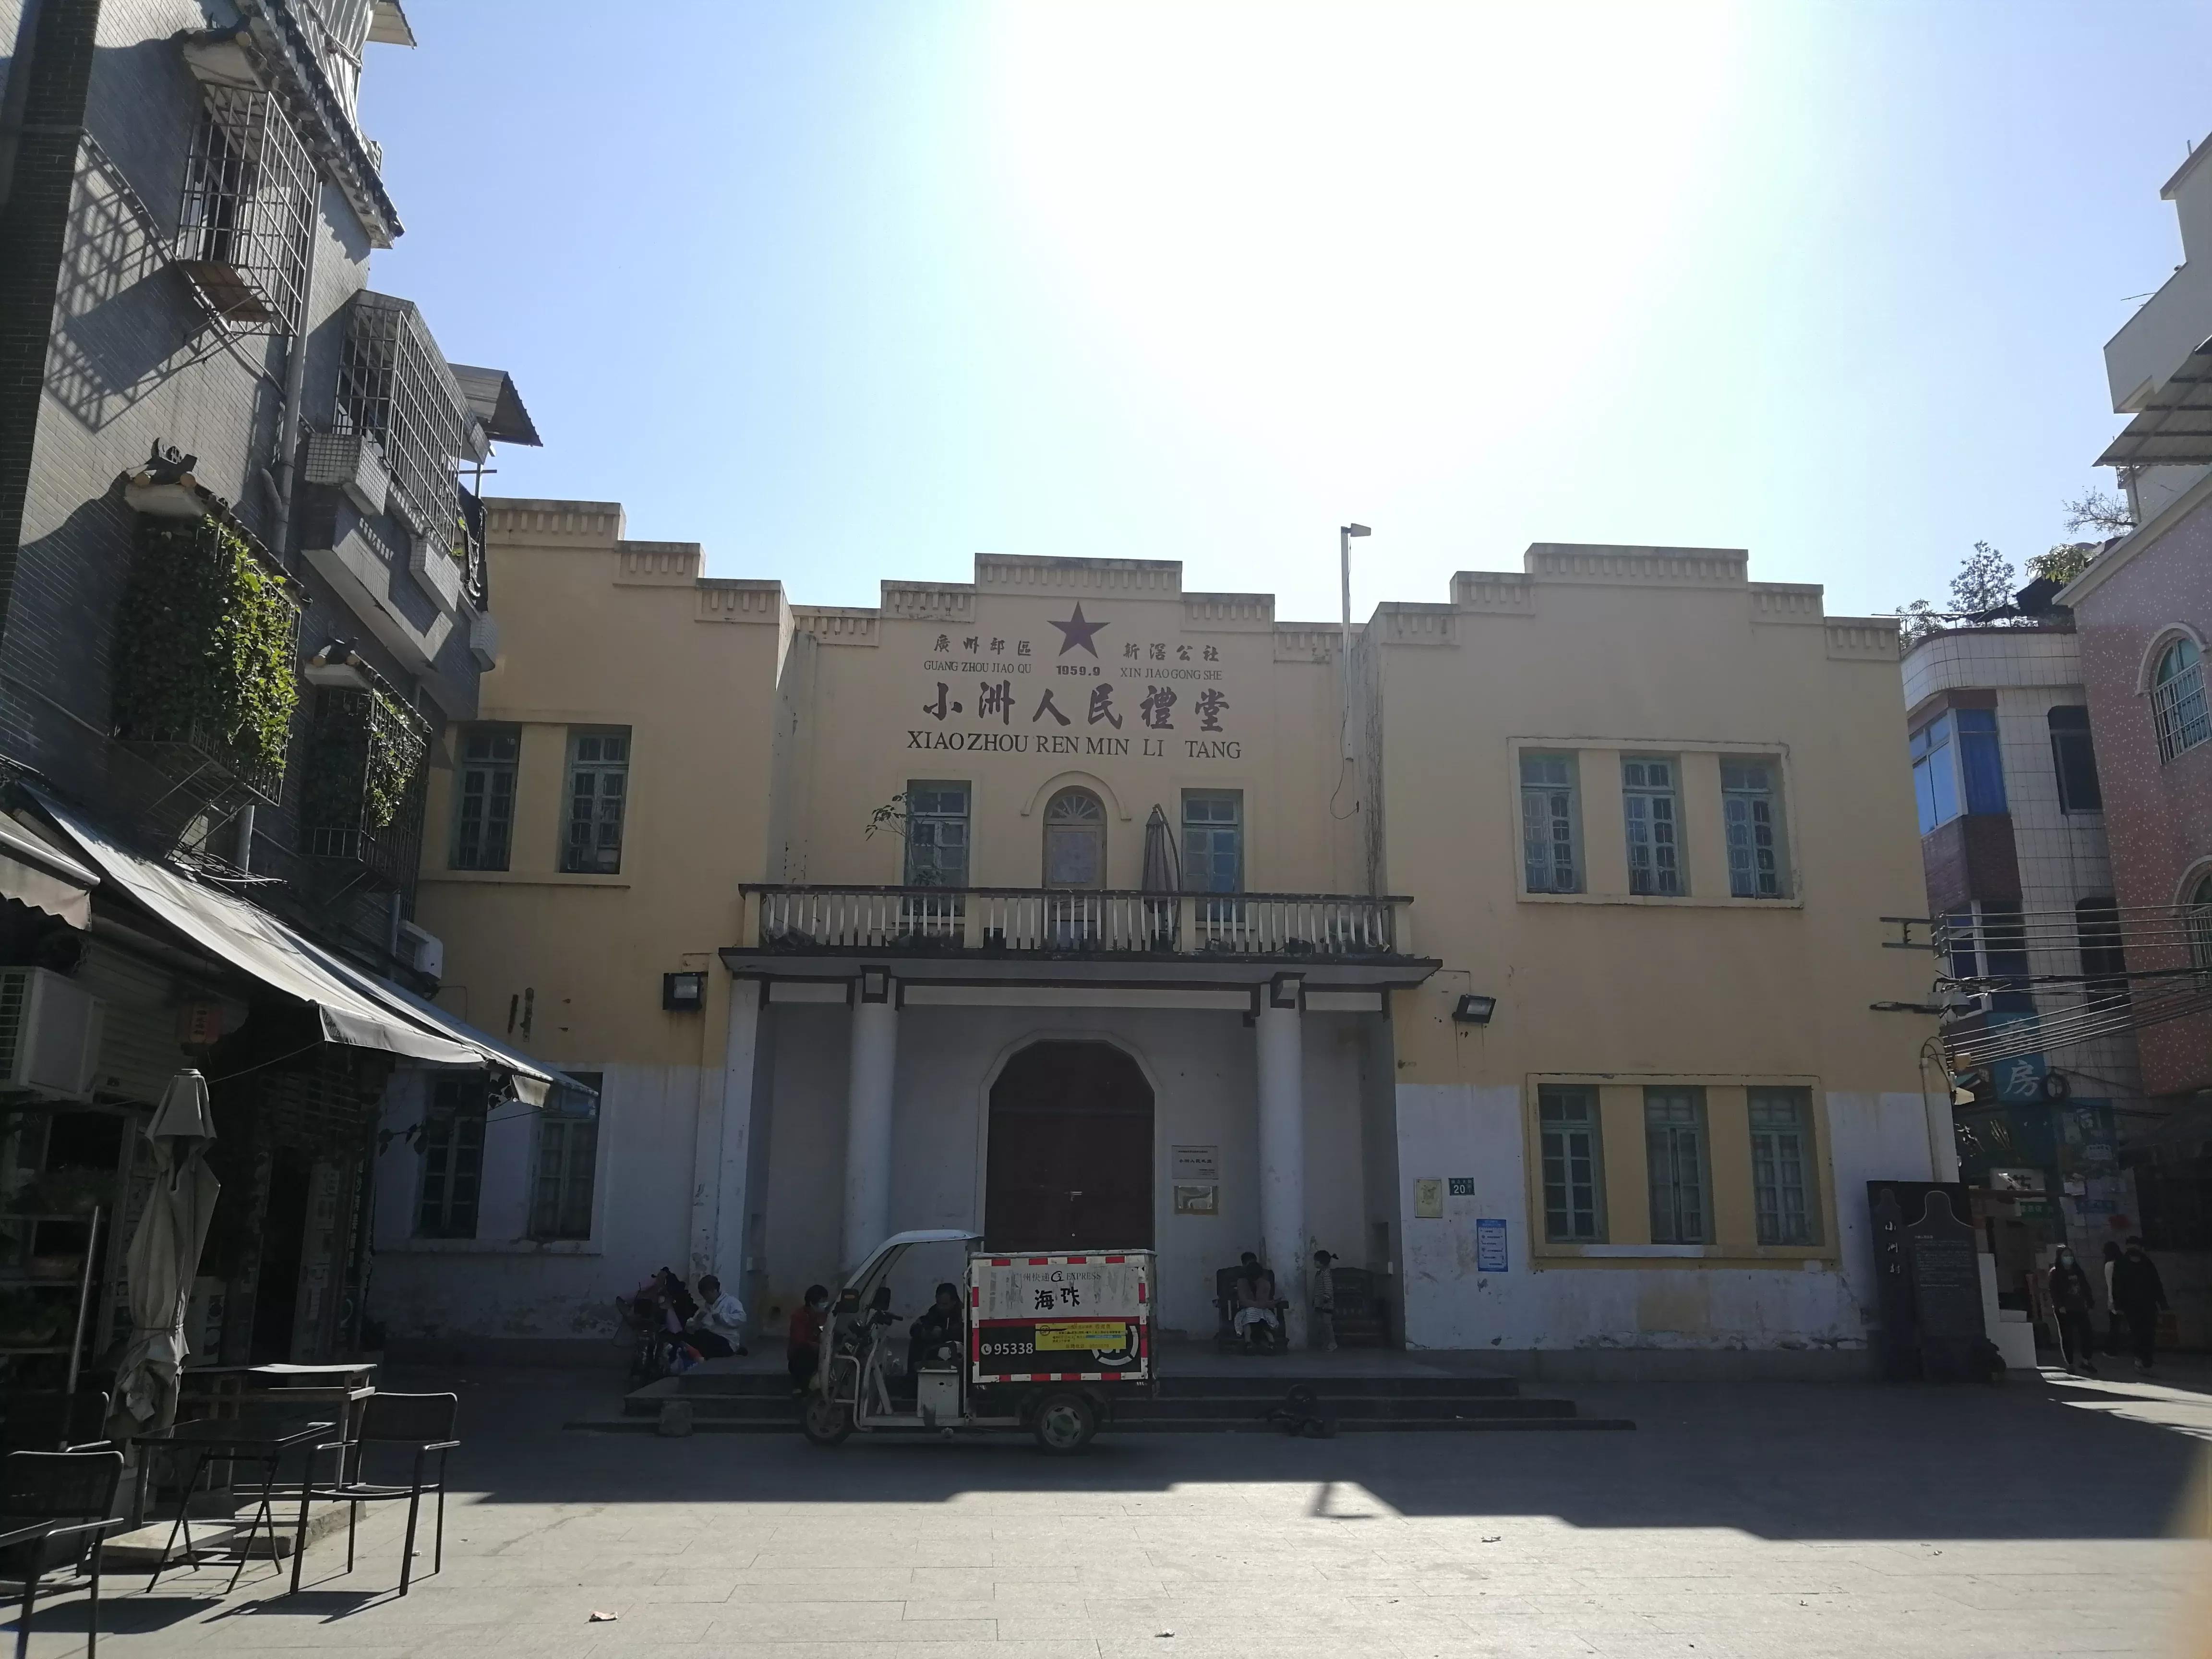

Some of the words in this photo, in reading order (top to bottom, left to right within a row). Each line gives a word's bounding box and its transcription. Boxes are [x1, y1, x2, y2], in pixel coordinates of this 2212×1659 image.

[925, 661, 959, 672] GUANG
[962, 662, 989, 673] ZHOU
[992, 663, 1014, 673] JIAO
[1018, 664, 1032, 674] QU
[1056, 666, 1100, 676] 1959.9
[1121, 668, 1141, 678] XIN
[1204, 671, 1222, 680] SHE
[923, 680, 1229, 732] 小洲人民禮堂
[1036, 736, 1080, 754] REN
[1086, 737, 1130, 755] MIN
[1143, 739, 1164, 757] LI
[1185, 741, 1241, 759] TANG
[1453, 1185, 1466, 1194] 20
[1067, 1272, 1102, 1281] EXPRESS
[1034, 1286, 1080, 1310] 海珠
[994, 1343, 1034, 1355] 95338
